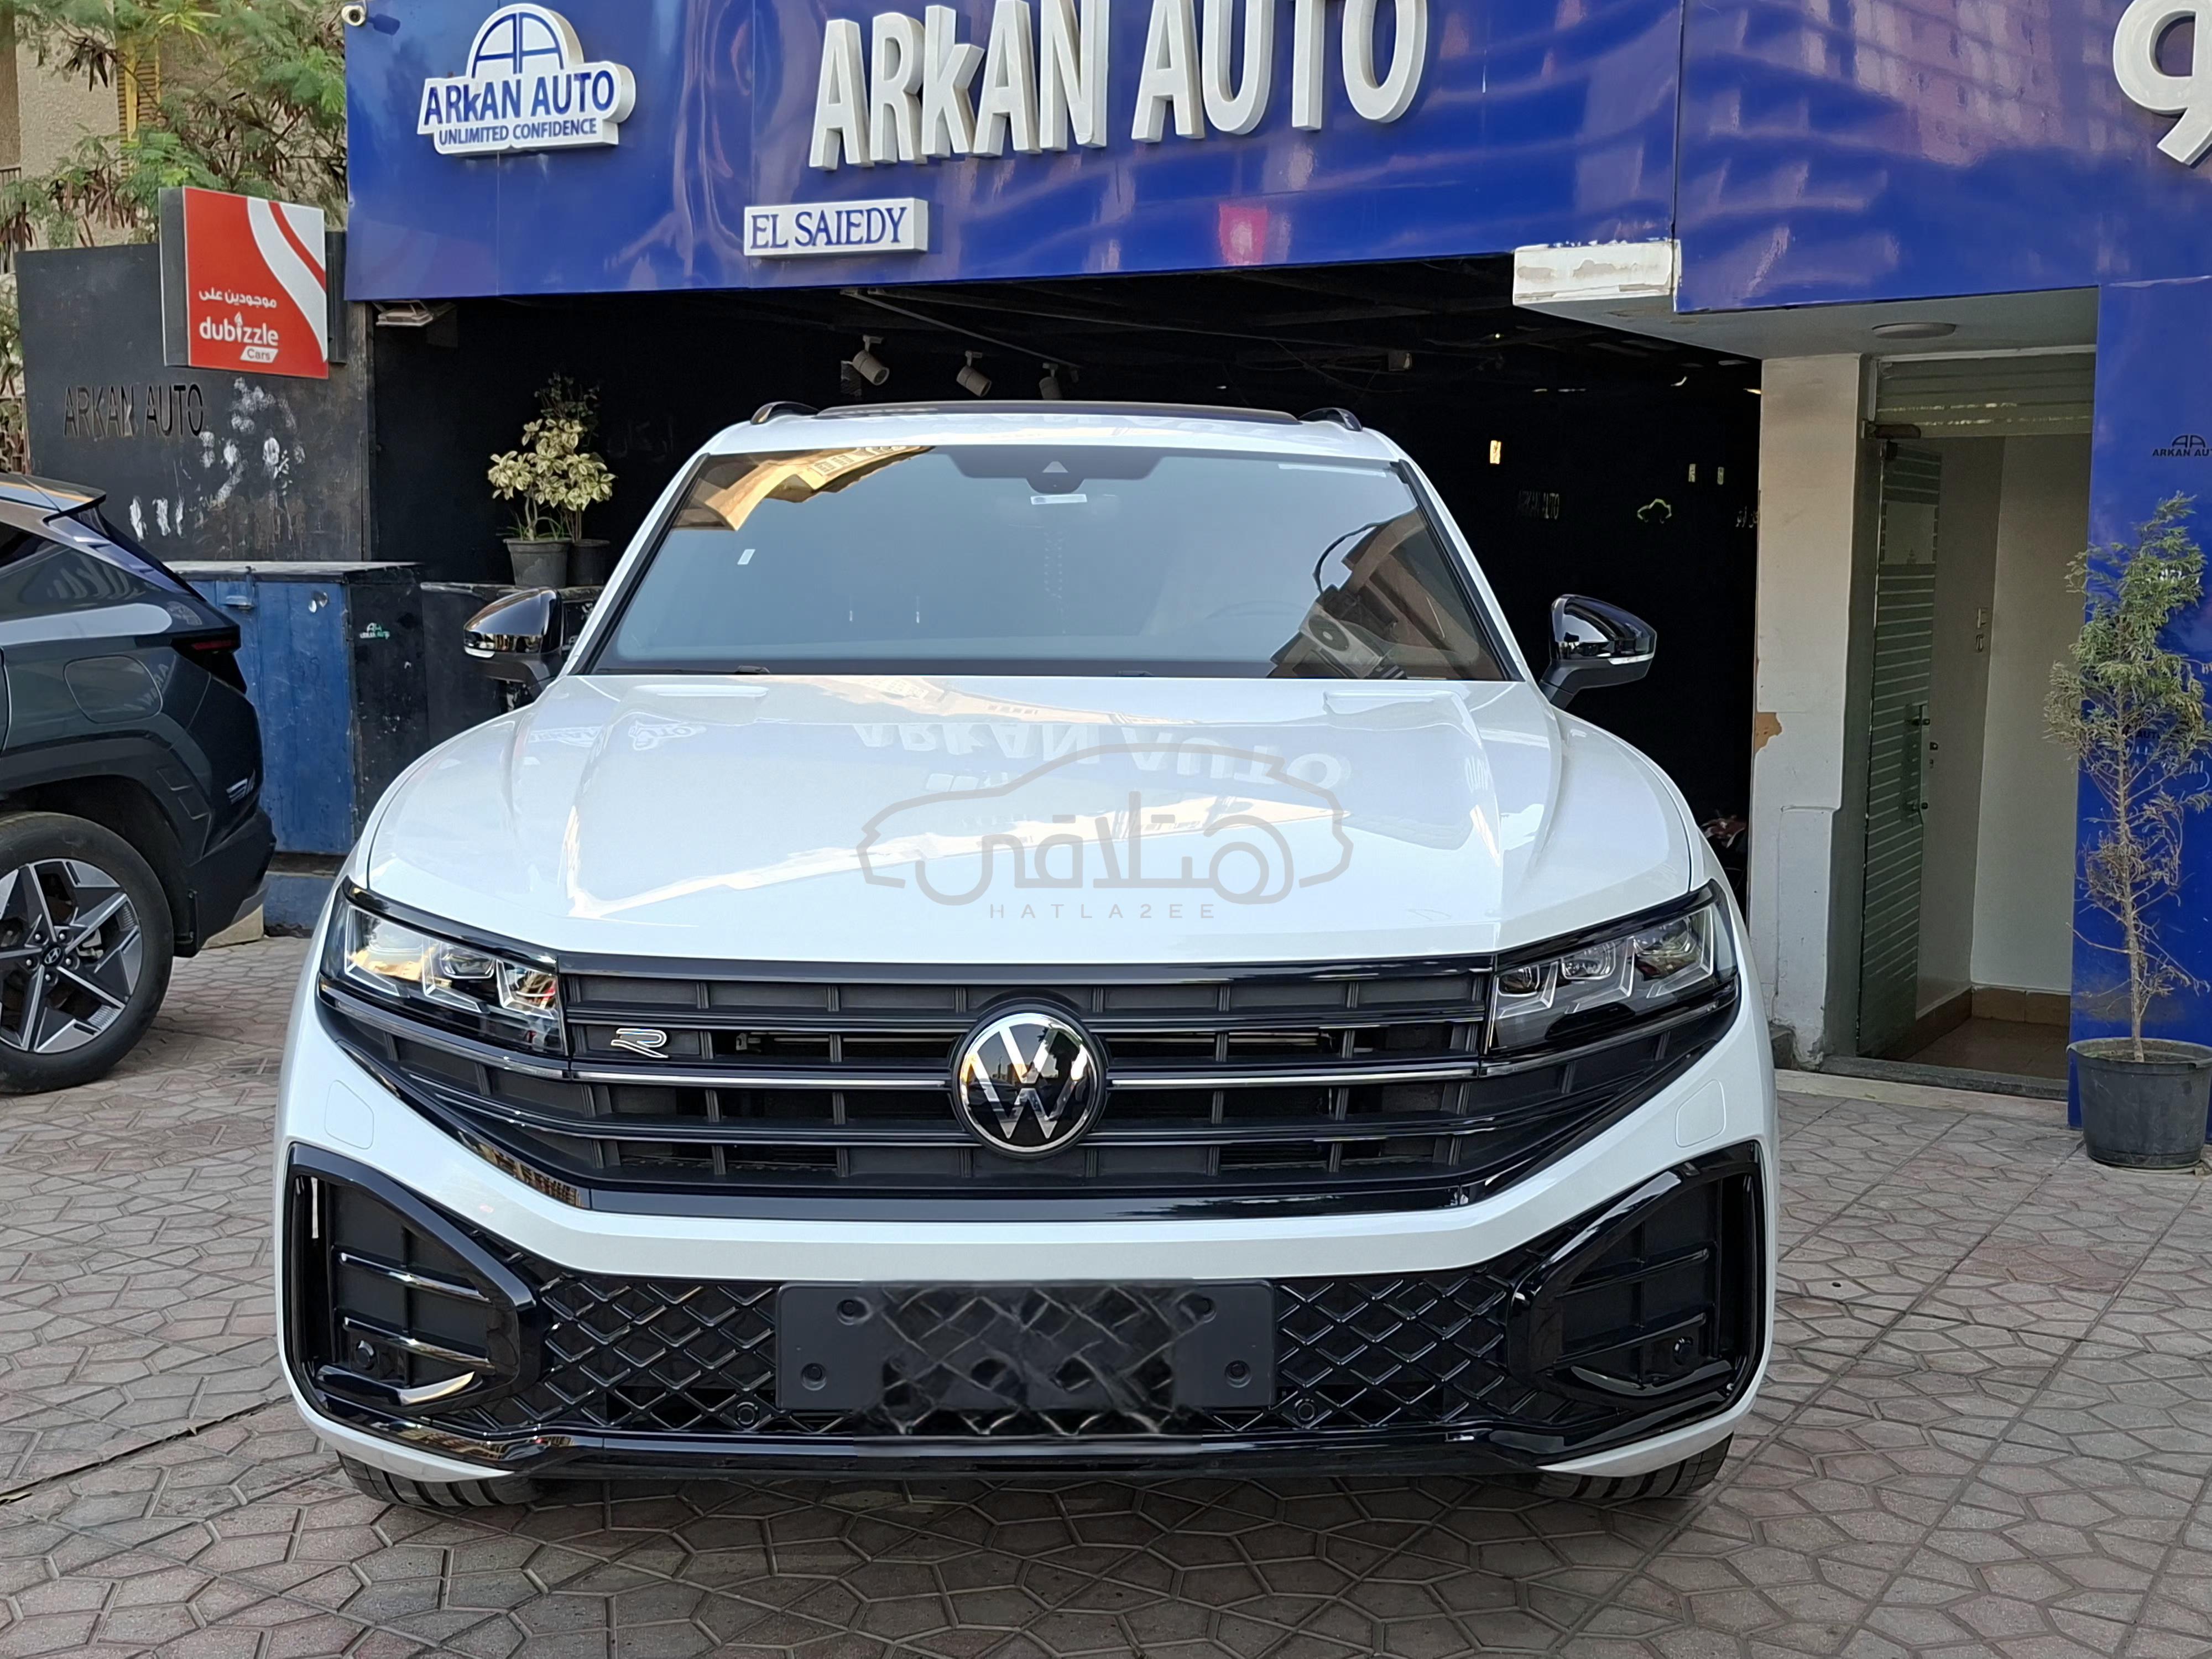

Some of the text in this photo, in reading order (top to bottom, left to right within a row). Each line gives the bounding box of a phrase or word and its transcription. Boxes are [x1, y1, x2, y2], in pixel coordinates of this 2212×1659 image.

[530, 70, 615, 116] AUTO
[439, 118, 597, 146] UNLIMITED CONFIDENCE
[750, 206, 907, 249] EL SAIEDY
[225, 289, 277, 308] موجودين
[199, 311, 279, 346] dubizzle
[247, 348, 271, 360] Cars
[63, 384, 204, 436] ARKAN AUTO
[2152, 448, 2212, 457] ARKAN AU
[2136, 730, 2161, 739] AUT
[611, 1029, 668, 1058] R
